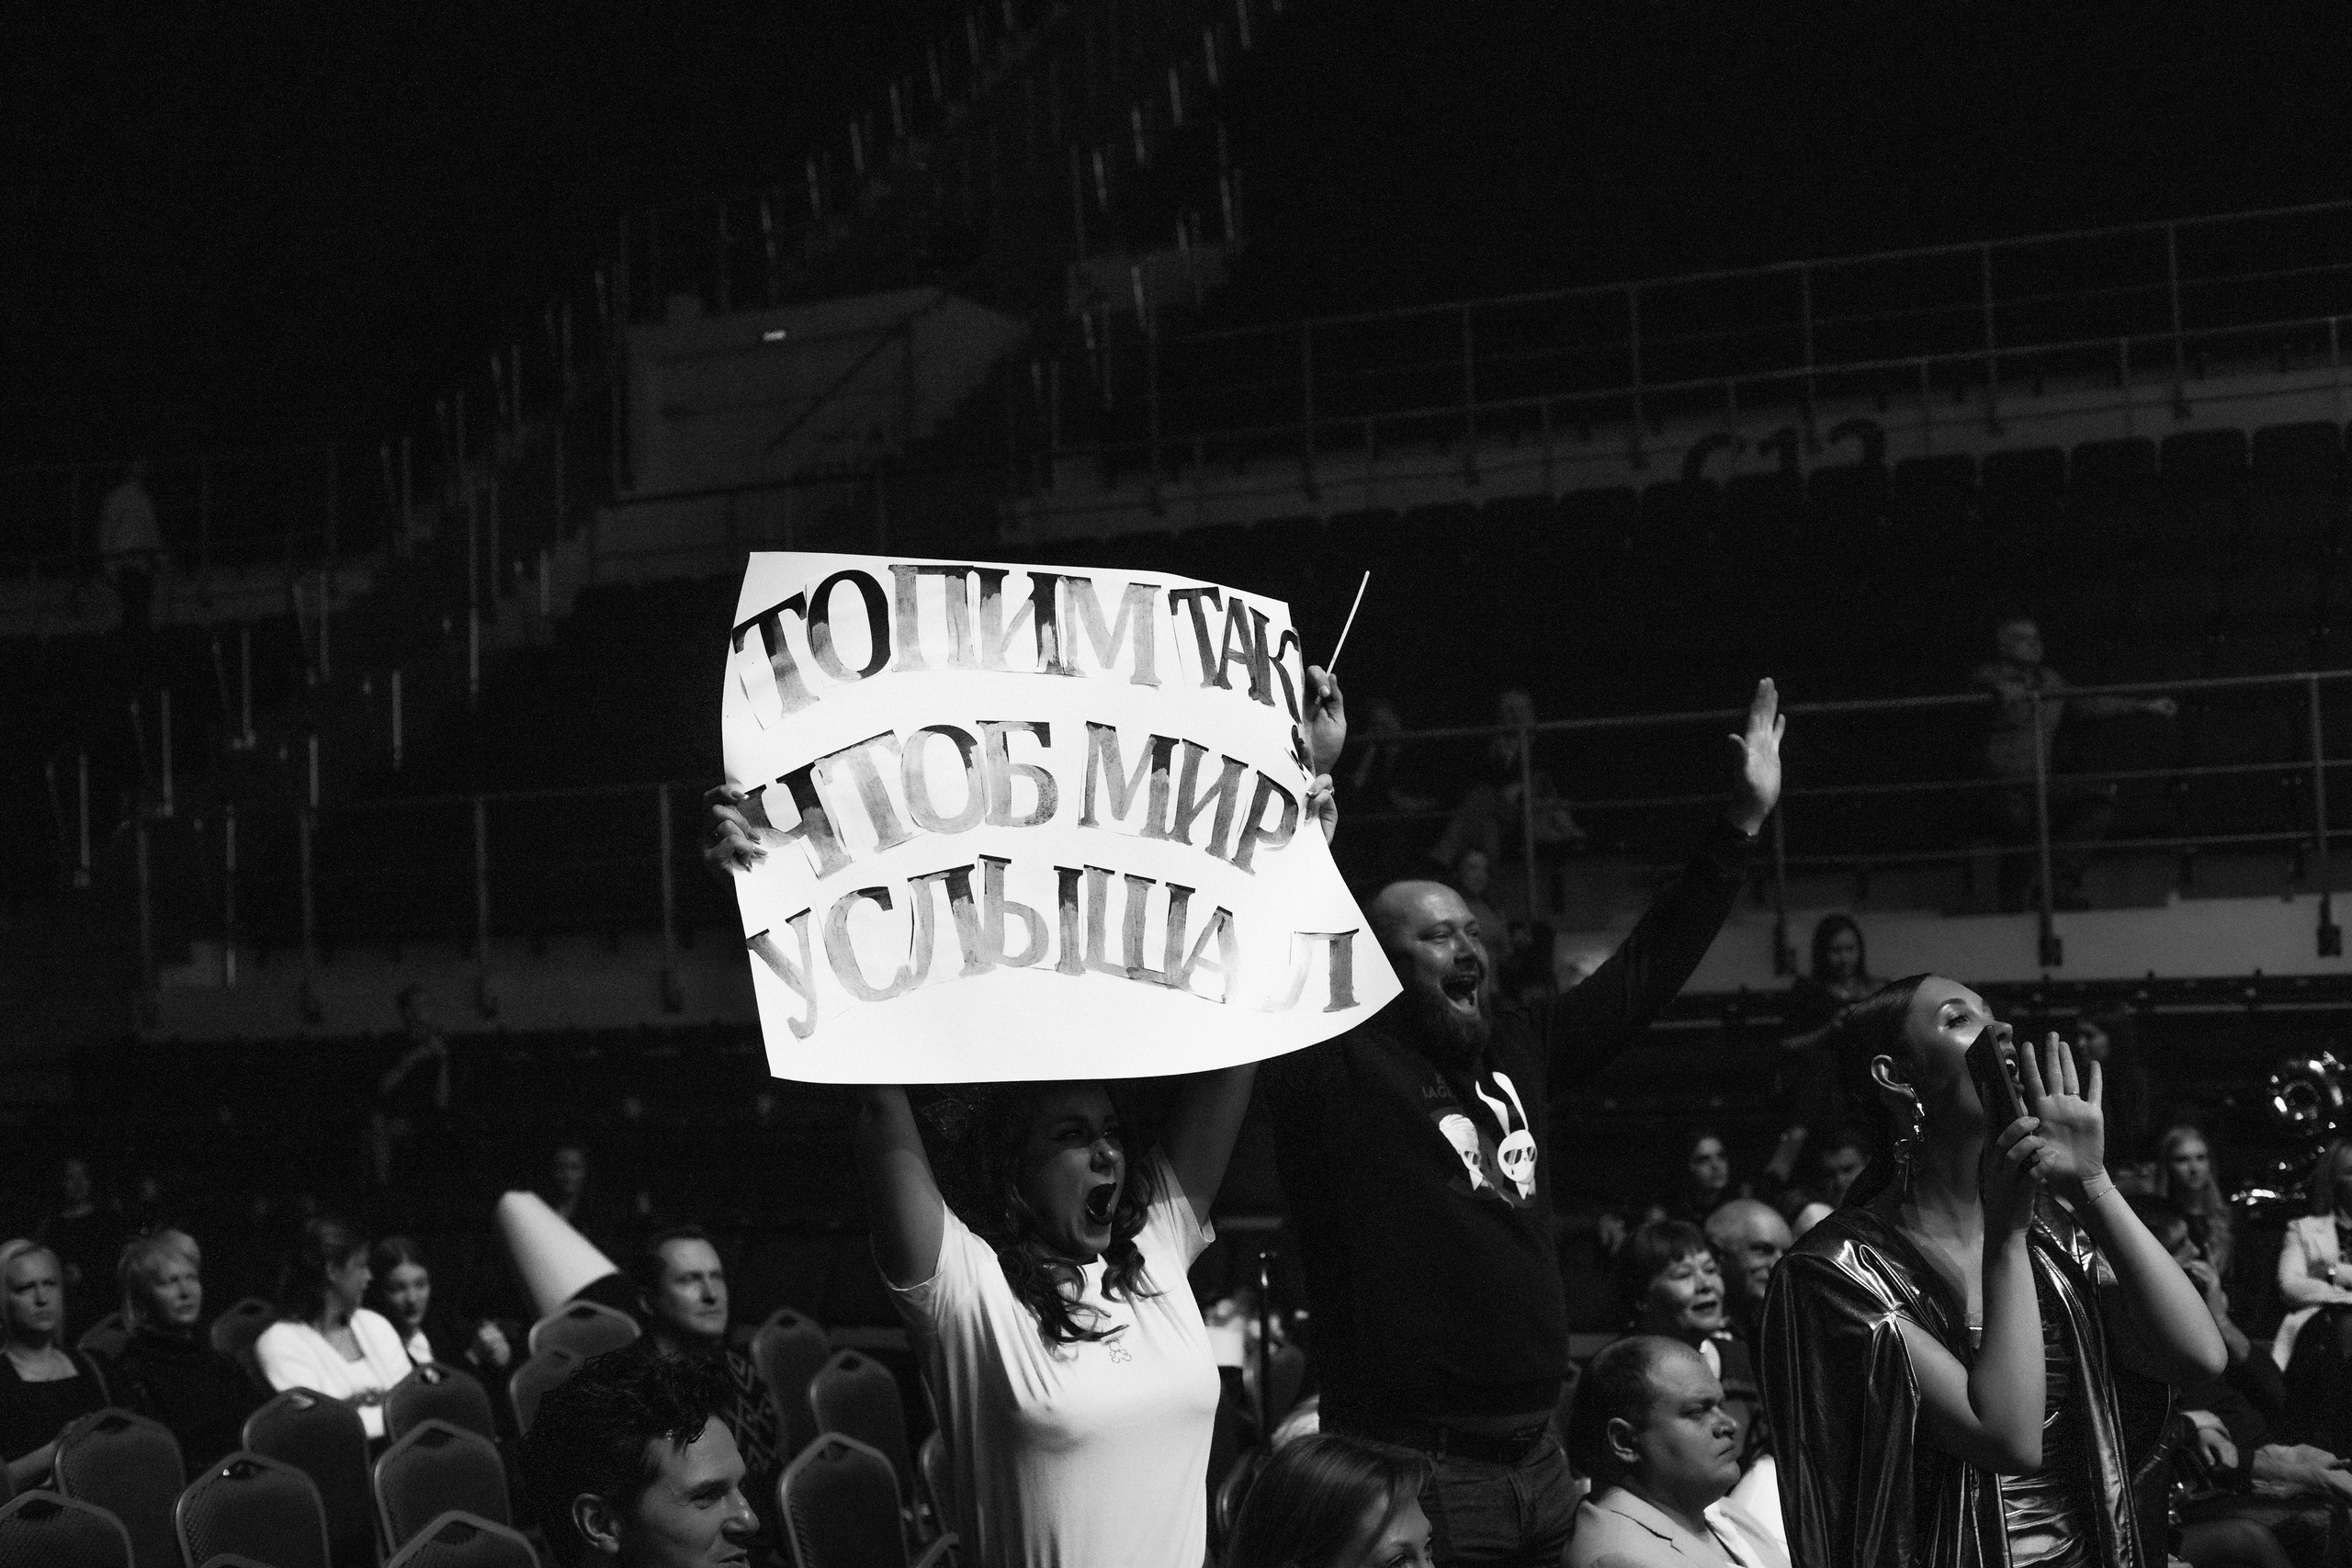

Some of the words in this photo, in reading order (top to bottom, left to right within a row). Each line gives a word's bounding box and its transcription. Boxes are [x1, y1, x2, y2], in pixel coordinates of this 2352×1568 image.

[732, 564, 1162, 718] ТОПИМ
[737, 720, 1057, 879] ЧТОБ
[1077, 721, 1298, 875] МИР
[745, 854, 1361, 1042] УСЛЫШАЛ
